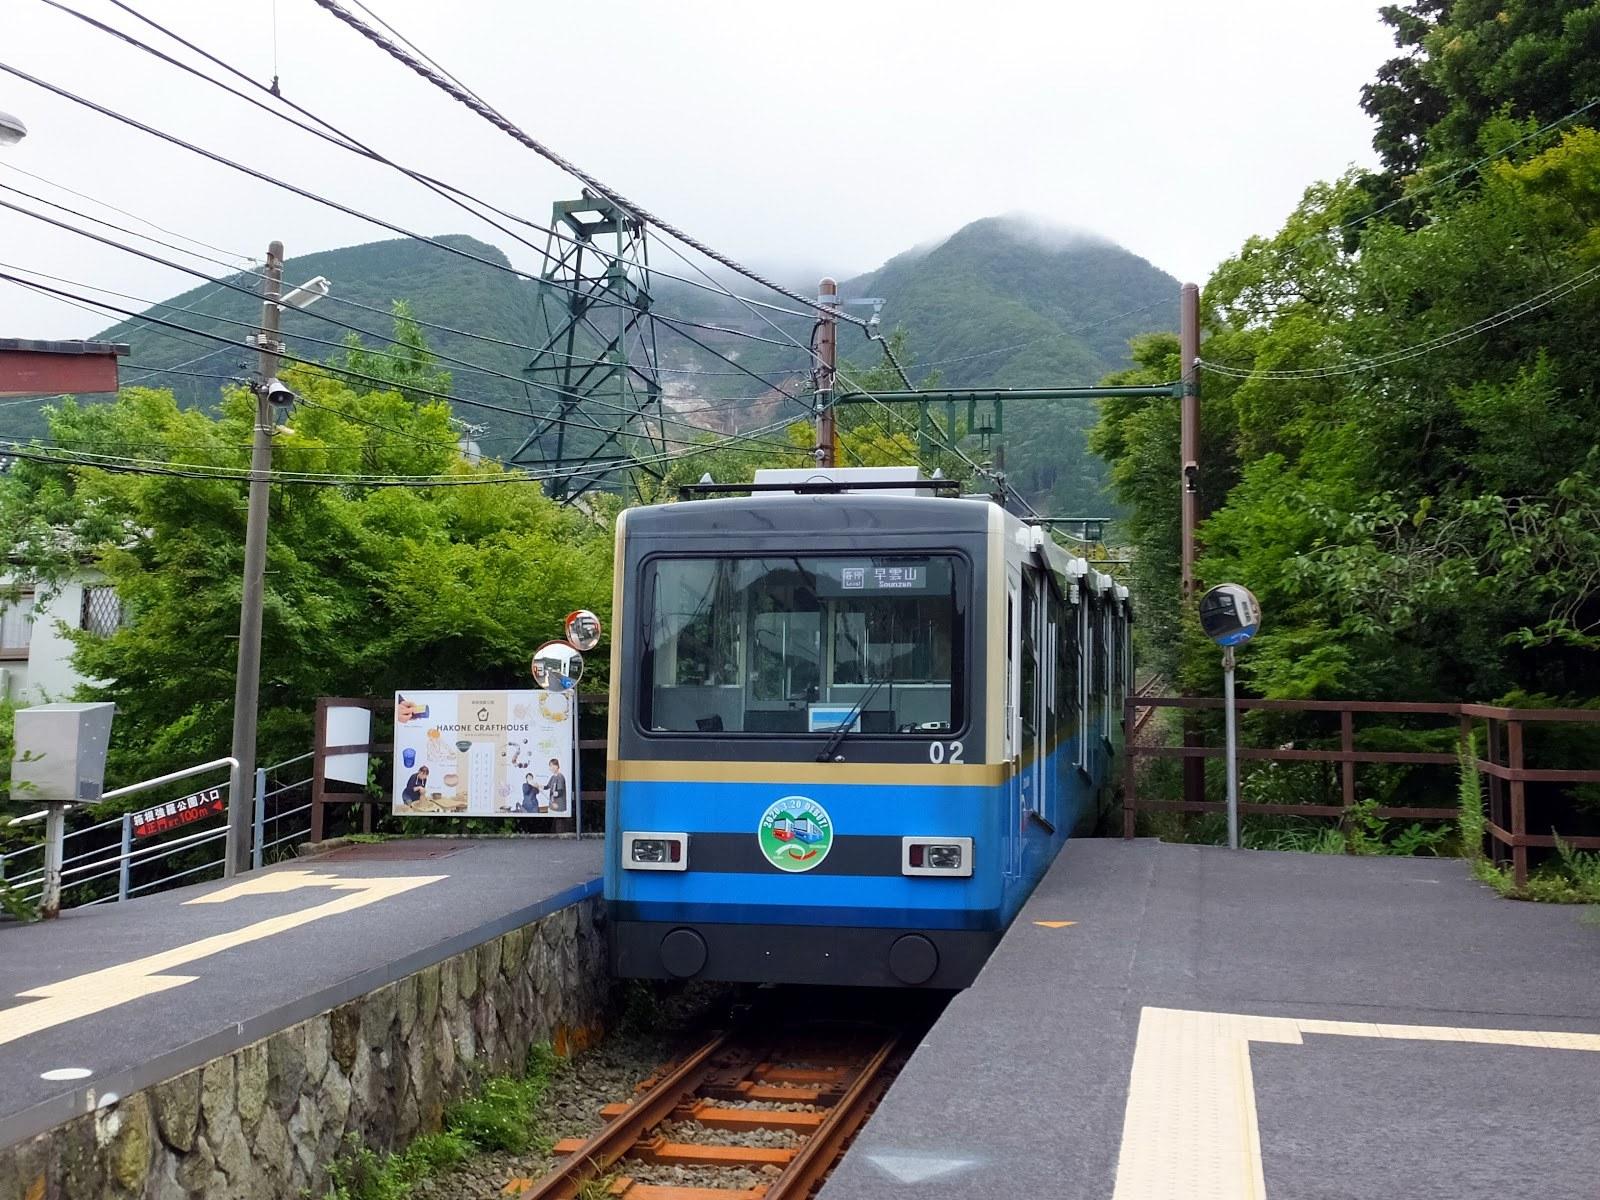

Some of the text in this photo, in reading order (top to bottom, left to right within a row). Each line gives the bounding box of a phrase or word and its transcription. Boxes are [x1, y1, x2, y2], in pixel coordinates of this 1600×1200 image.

[874, 567, 917, 581] 早雲山
[436, 723, 529, 732] HAKONE CRAFTHOUSE
[929, 741, 964, 765] 02
[133, 789, 220, 827] 箱根強羅公園入口
[763, 799, 829, 829] 2020.3.20 DEBUT!
